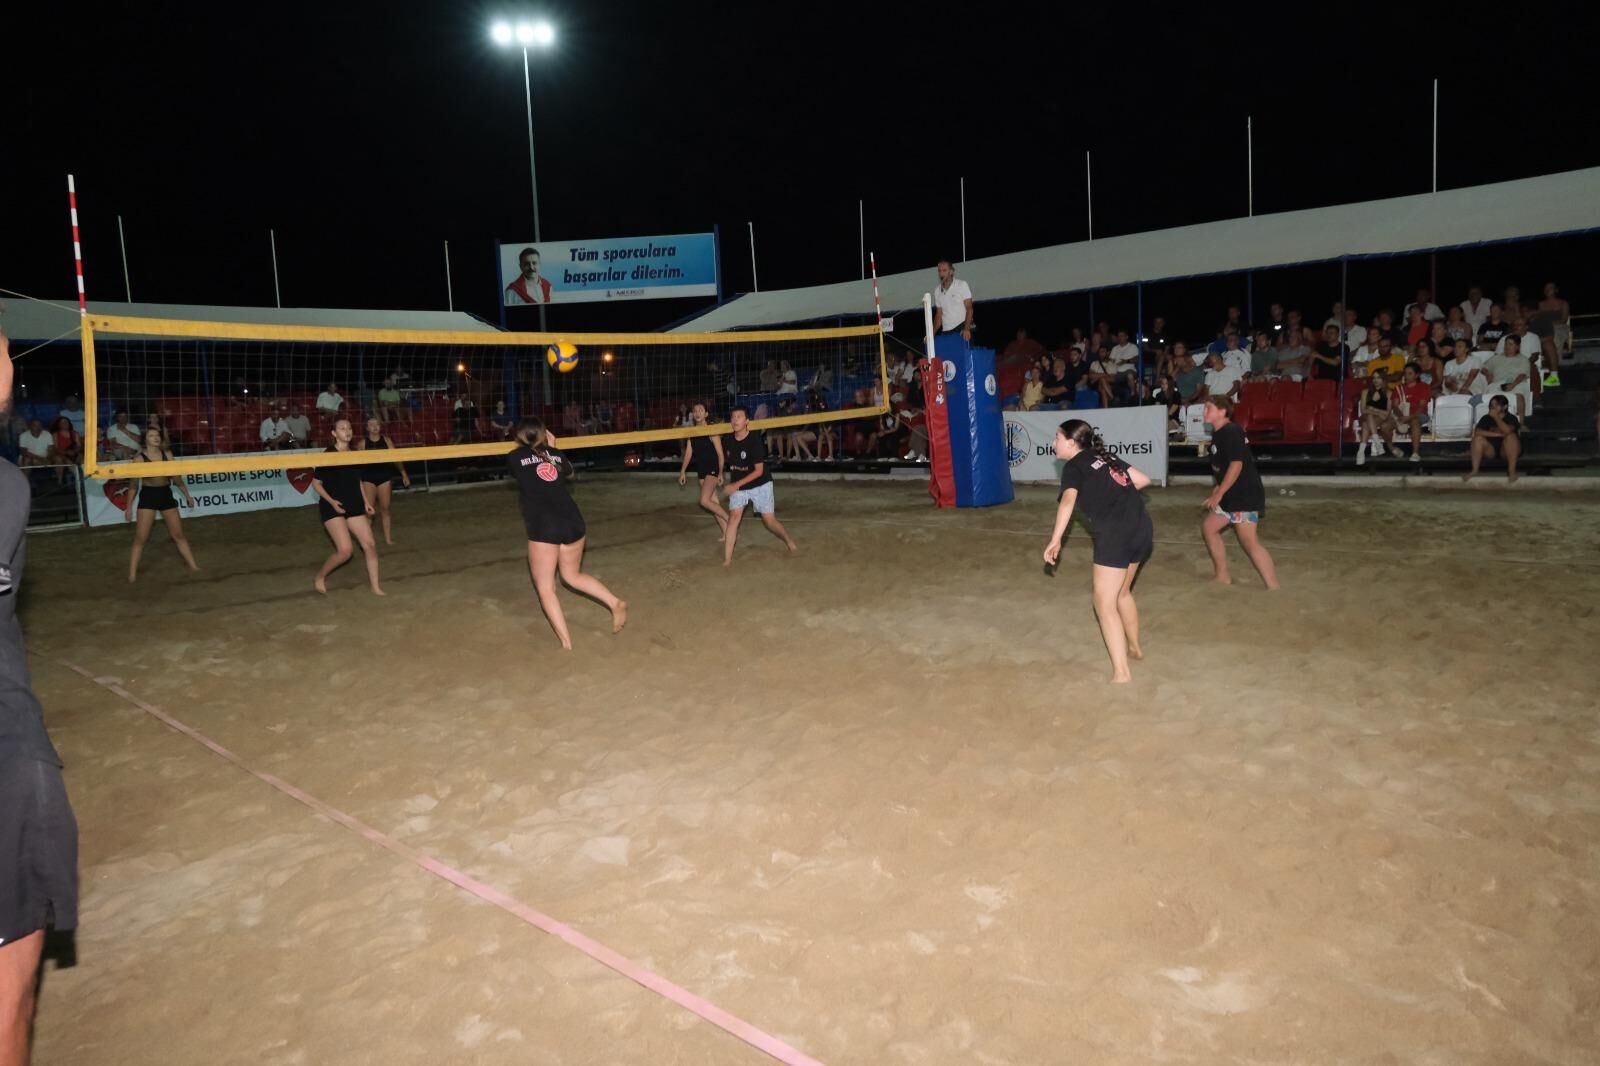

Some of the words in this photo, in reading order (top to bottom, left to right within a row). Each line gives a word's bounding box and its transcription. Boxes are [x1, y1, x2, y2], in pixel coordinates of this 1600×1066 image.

[570, 247, 599, 262] Tüm
[603, 244, 675, 262] sporculara
[563, 267, 626, 286] başarılar
[631, 265, 684, 280] dilerim.
[1036, 443, 1056, 456] DİK
[250, 469, 281, 480] SPOR
[231, 490, 274, 504] TAKIMI
